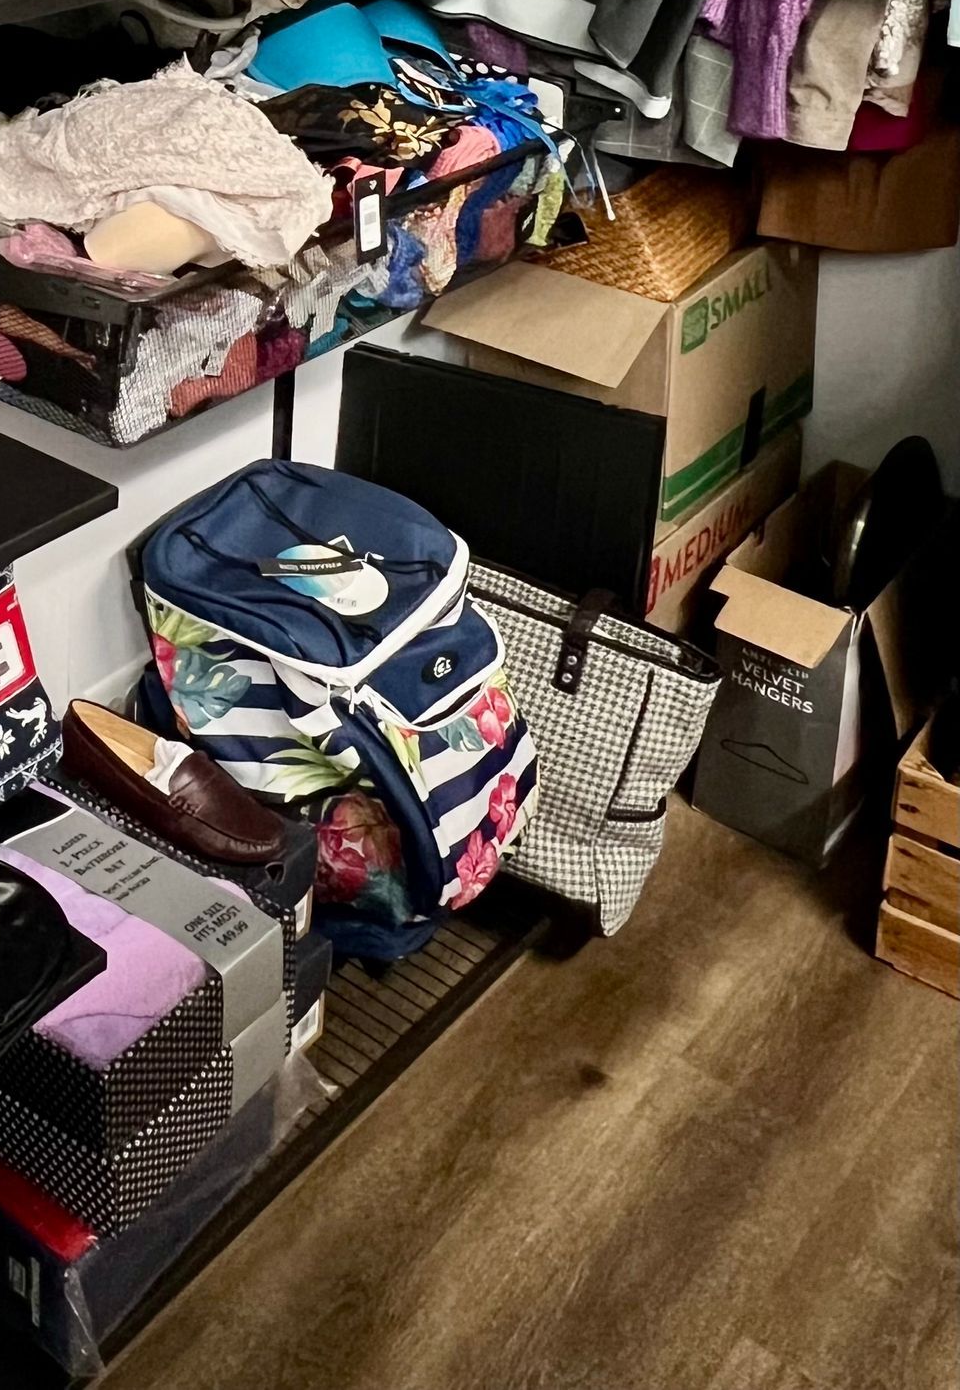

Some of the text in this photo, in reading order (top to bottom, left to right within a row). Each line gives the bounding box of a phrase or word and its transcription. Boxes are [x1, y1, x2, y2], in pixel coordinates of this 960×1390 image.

[659, 496, 752, 593] MEDIUM
[731, 670, 814, 714] HANGERS
[742, 657, 805, 694] VELVET
[184, 901, 226, 933] ONE SIZE
[193, 905, 241, 942] FITS MOST
[216, 921, 249, 947] $49.99
